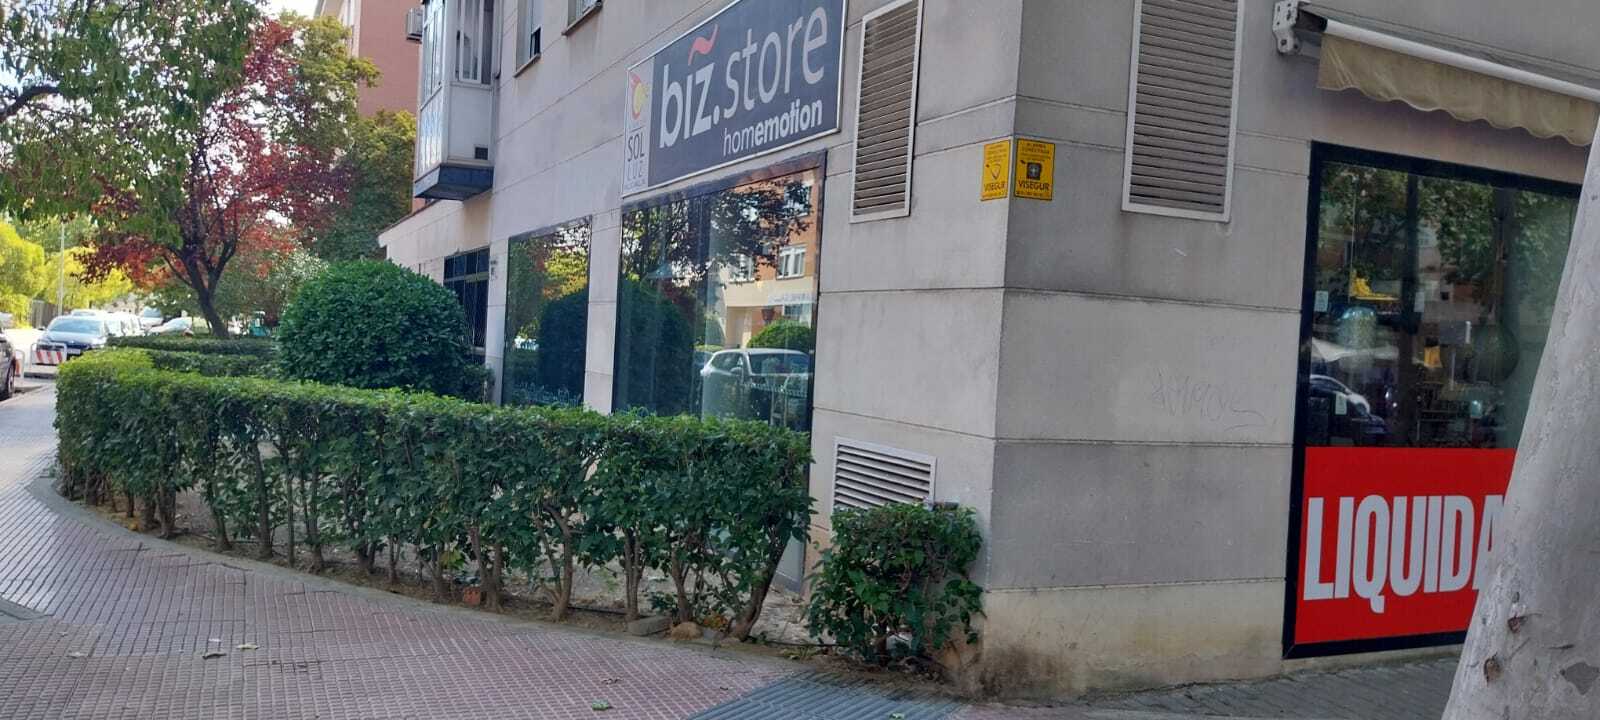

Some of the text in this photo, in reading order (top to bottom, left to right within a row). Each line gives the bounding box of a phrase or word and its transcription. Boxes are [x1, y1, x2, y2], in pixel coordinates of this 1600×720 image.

[723, 98, 823, 157] homemotion
[627, 131, 645, 162] SOL
[1018, 180, 1050, 191] VISEGUR
